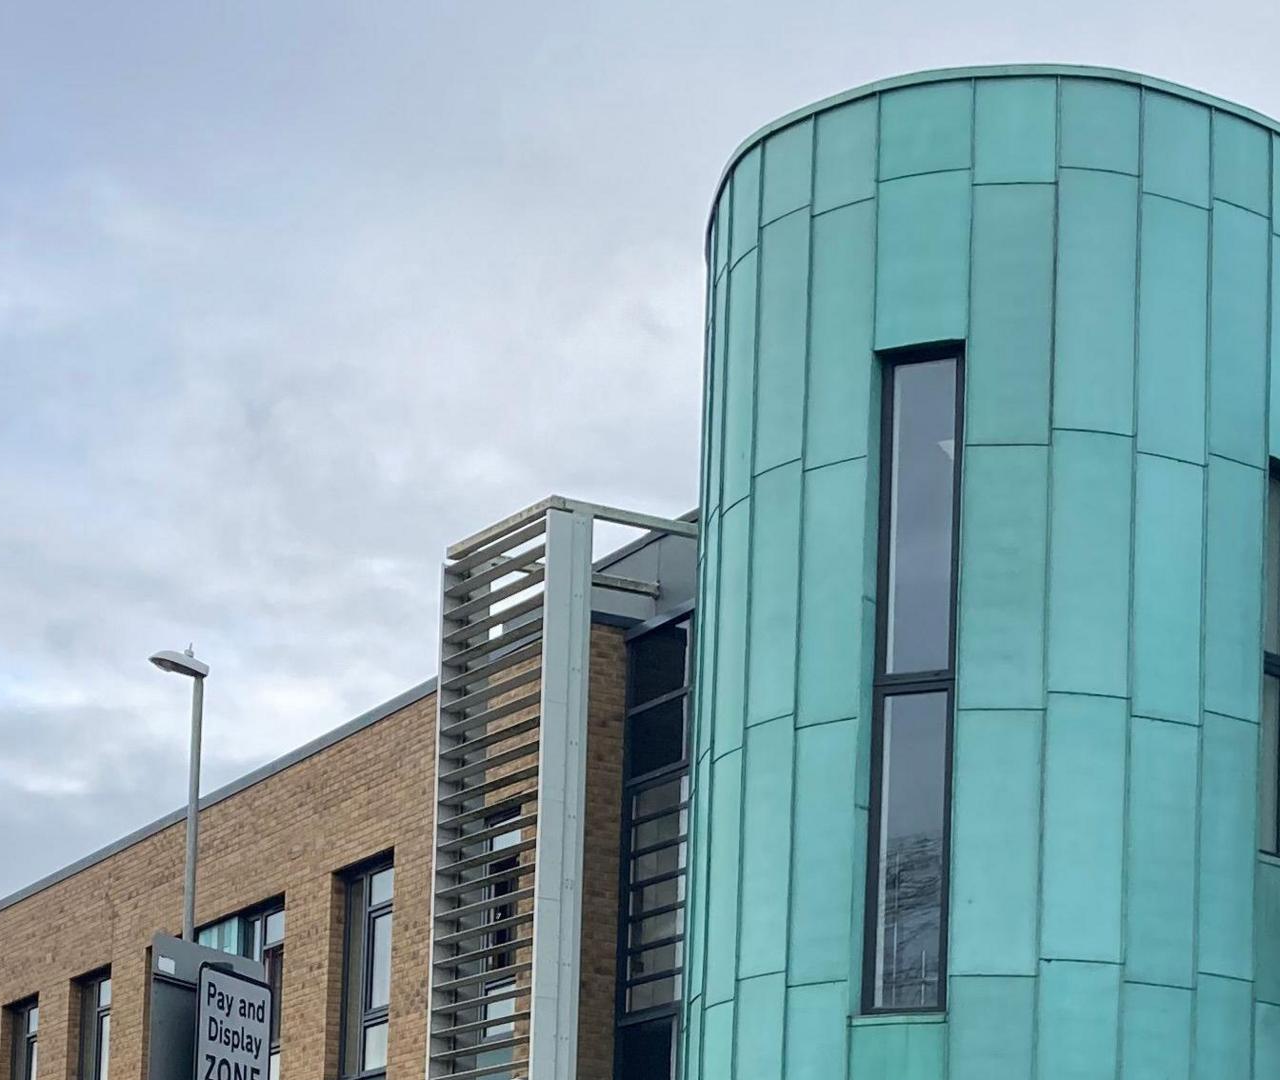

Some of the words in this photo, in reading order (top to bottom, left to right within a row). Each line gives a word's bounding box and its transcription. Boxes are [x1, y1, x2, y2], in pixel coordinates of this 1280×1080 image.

[207, 981, 234, 1017] Pay
[238, 998, 265, 1023] and
[208, 1016, 262, 1060] Display
